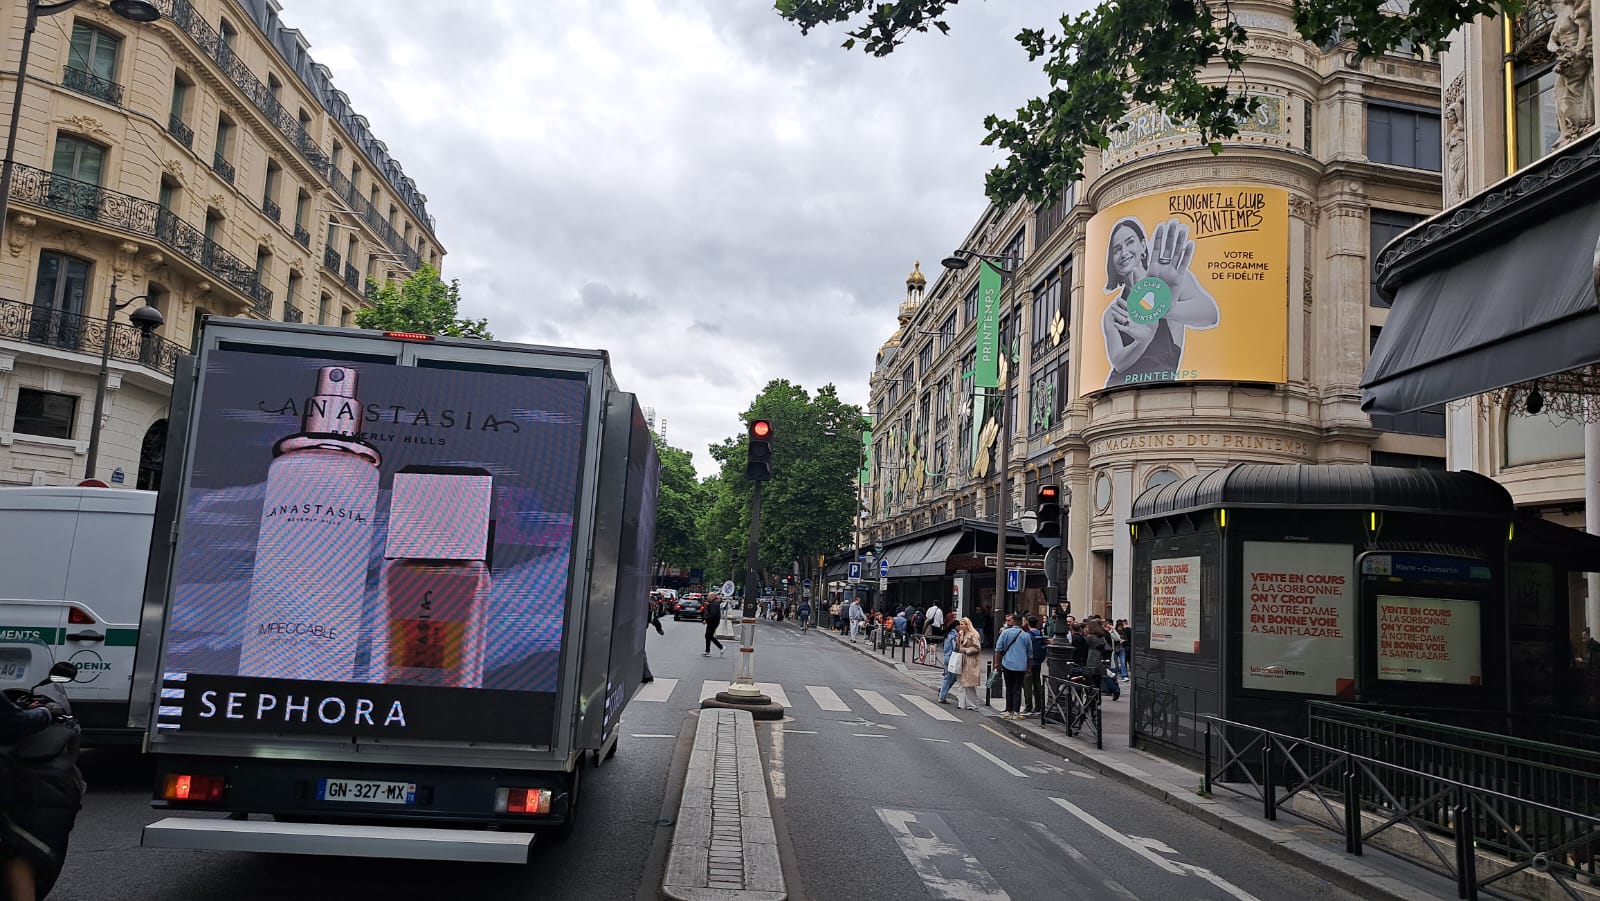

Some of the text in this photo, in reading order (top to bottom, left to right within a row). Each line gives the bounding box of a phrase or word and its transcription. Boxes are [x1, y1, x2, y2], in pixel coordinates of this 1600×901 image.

[1169, 192, 1266, 211] REJOIGNEZ LE CLUB
[1223, 251, 1254, 259] VOTRE
[1207, 261, 1269, 271] PROGRAMME
[1211, 270, 1265, 281] DE FIDÉLITÉ
[1143, 280, 1161, 289] CLUB
[982, 287, 995, 362] PRINTEMPS
[1124, 369, 1198, 384] PRINTEMPS
[258, 397, 520, 434] ANASTASIA
[403, 435, 446, 447] HILLS
[1105, 434, 1175, 451] MAGASINS
[1186, 434, 1211, 447] DU
[1221, 435, 1308, 455] PRINTEMPS
[266, 503, 368, 526] ANASTASIA
[1250, 572, 1345, 585] VENTE EN COURS
[1261, 583, 1276, 593] LA
[1276, 584, 1343, 596] SORBONNE,
[1250, 593, 1316, 605] ON Y CROIT
[1261, 604, 1340, 618] NOTRE-DAME,
[1380, 605, 1453, 617] VENTE EN COURS
[1250, 614, 1337, 628] EN BONNE VOIE
[1389, 614, 1401, 623] LA
[1400, 615, 1450, 627] SORBONNE,
[1261, 625, 1344, 639] SAINT-LAZARE.
[1380, 623, 1431, 633] ON Y CROIT
[1389, 632, 1448, 644] NOTRE-DAME,
[1380, 640, 1446, 652] EN BONNE VOIE
[1389, 650, 1452, 661] SAINT-LAZARE.
[74, 661, 112, 671] OENIX
[1284, 668, 1306, 677] immo
[199, 690, 407, 728] SEPHORA
[328, 782, 405, 800] GN-327-MX
